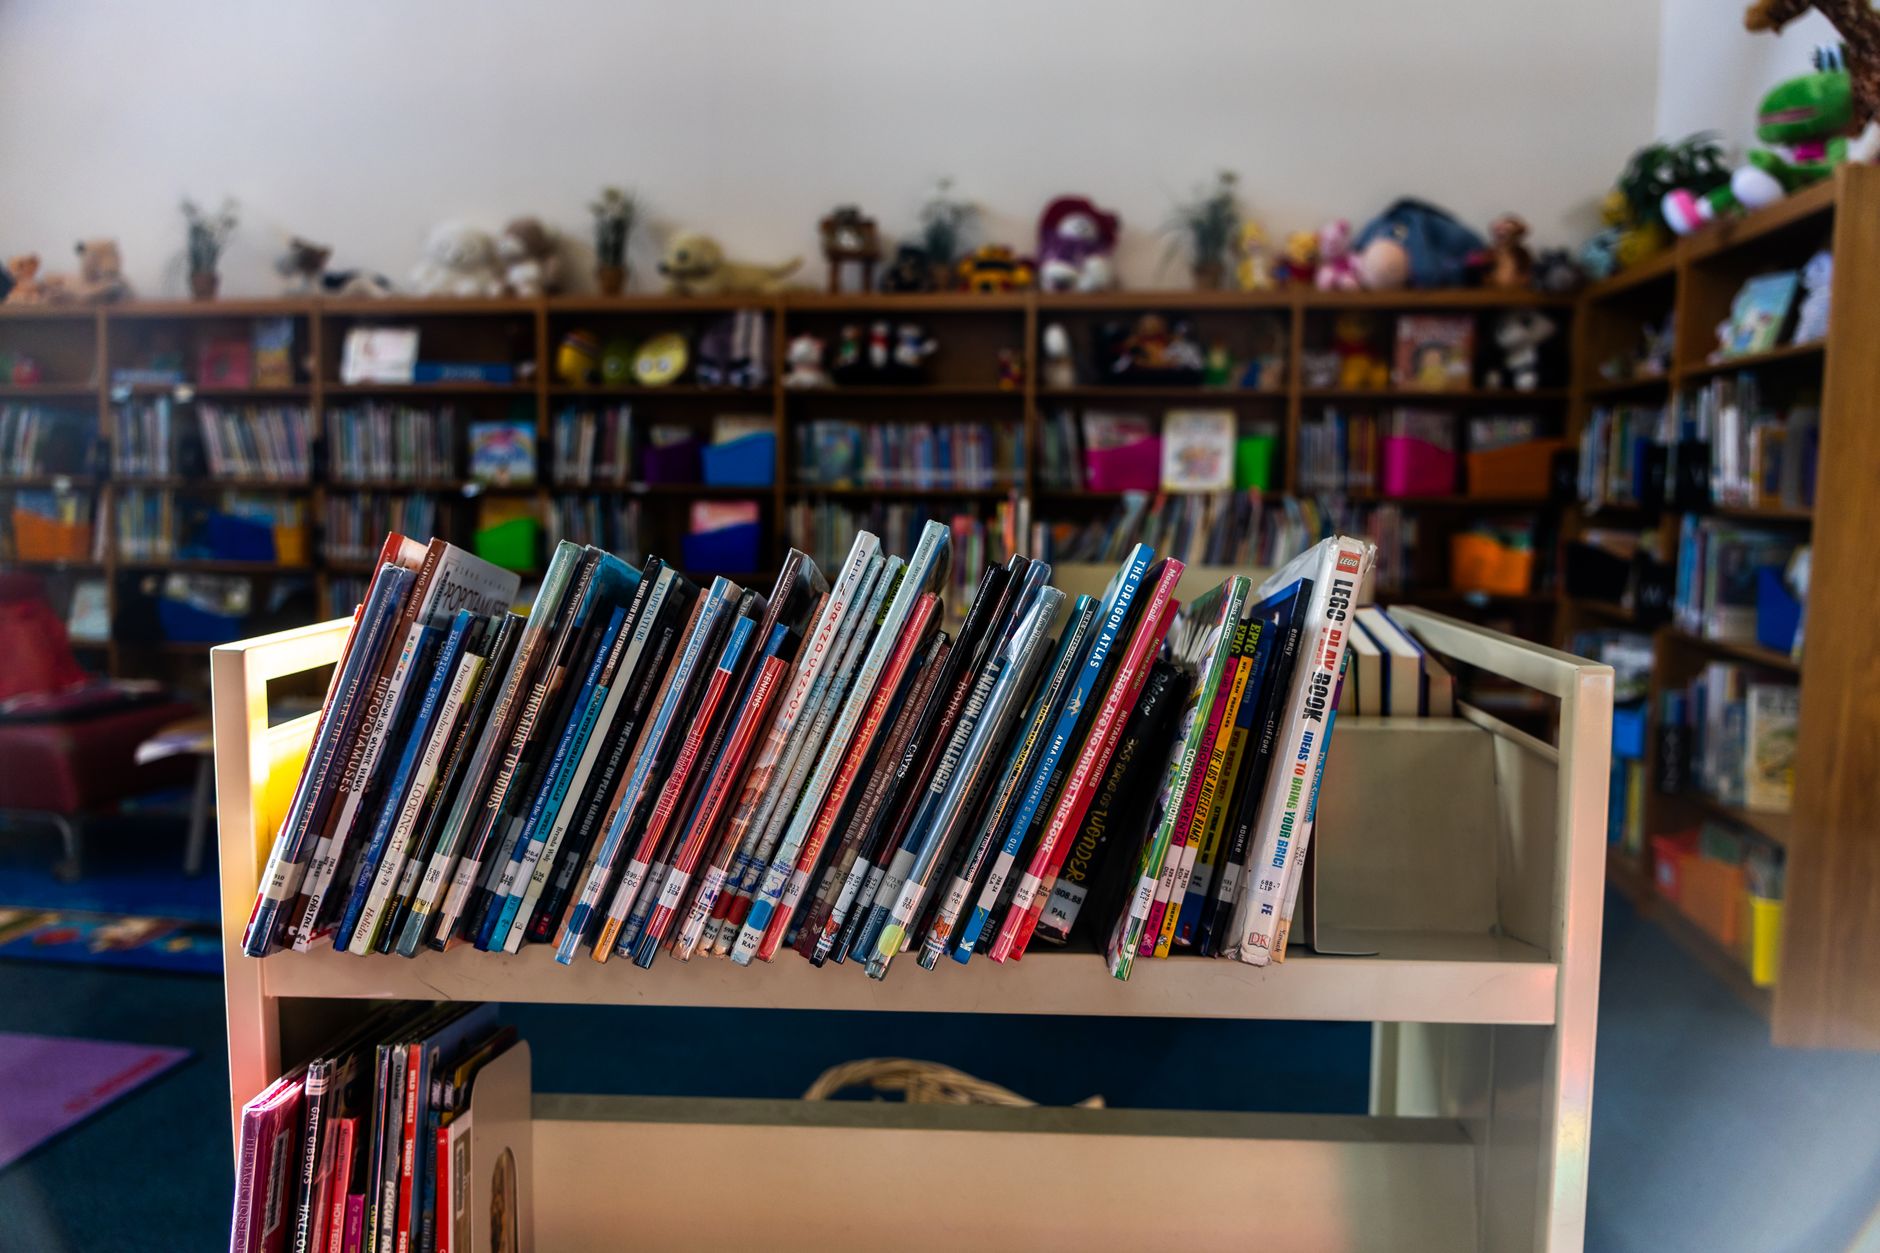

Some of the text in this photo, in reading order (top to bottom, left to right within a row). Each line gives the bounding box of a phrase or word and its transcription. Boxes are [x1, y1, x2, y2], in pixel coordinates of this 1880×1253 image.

[846, 549, 866, 581] CHIN
[908, 532, 936, 585] Rappaport Tavares
[1339, 555, 1358, 568] LEGO
[405, 586, 422, 618] ANIMALS
[1146, 567, 1176, 622] Mosco Pirolli
[605, 578, 649, 669] TRAVEL WITH THE GREAT EXPLORERS
[631, 580, 667, 643] TEMPERATURE
[1035, 616, 1046, 629] for
[1041, 608, 1049, 617] is
[1088, 558, 1145, 669] THE DRAGON ATLAS
[671, 596, 718, 693] My Teacher Likes to Say
[1022, 628, 1040, 655] Rhyme
[1144, 636, 1159, 663] Machines
[1230, 623, 1247, 654] EPIC
[1243, 623, 1262, 654] EPIC
[1301, 577, 1353, 723] LEGO PLAY BOOK
[433, 629, 458, 683] ELECTRICAL
[585, 645, 608, 686] David Stewart
[782, 600, 843, 721] GRAND CANYON
[750, 670, 773, 708] JENKINS
[807, 673, 827, 702] PALE
[1132, 670, 1144, 690] Motion
[1234, 677, 1242, 693] TEAM
[337, 677, 359, 718] POLAR
[379, 689, 396, 719] LONDON
[419, 686, 437, 719] STORMS
[488, 695, 513, 729] Eagles
[939, 680, 968, 728] BONES
[1223, 696, 1237, 728] PROFILES
[421, 663, 472, 767] Dorothy Hinshaw Patent
[566, 723, 576, 735] You
[928, 661, 999, 794] A NATION CHALLENGED
[329, 721, 343, 744] THE
[338, 675, 390, 794] HIPPOPOTAMUSES
[484, 681, 549, 811] DINOSAURS TO DODOS
[554, 734, 572, 761] Wouldn't
[1088, 709, 1127, 787] MILITARY MACHINES
[1297, 730, 1314, 761] IDEAS
[361, 735, 378, 767] OLYMPIC
[673, 755, 692, 778] book
[896, 743, 918, 778] CAVES
[1040, 666, 1132, 854] There Are No Ants in This Book
[309, 748, 333, 798] TITANIC
[351, 766, 367, 793] VENUES
[544, 777, 552, 785] to
[547, 761, 560, 778] Want
[578, 720, 634, 836] THE ATTACK ON PEARL HARBOR
[770, 765, 787, 789] Hawk
[802, 685, 890, 864] THE BURGER AND THE HOT
[1293, 761, 1307, 776] TO
[536, 796, 544, 805] on
[540, 784, 550, 797] Sail
[654, 784, 680, 819] SLOTH
[766, 788, 776, 798] of
[855, 760, 895, 840] Life During the GOLD RUSH
[1031, 768, 1062, 825] FIRST RESPONDERS
[1164, 747, 1196, 826] CICADA SYMPHONY
[1188, 748, 1224, 842] THE LOS ANGELES RAMS
[1285, 776, 1303, 809] BRING
[297, 800, 315, 832] BEAR
[389, 781, 427, 852] LOOKING AT
[531, 804, 541, 816] the
[693, 793, 718, 835] SECOND
[760, 797, 772, 813] New
[536, 810, 553, 836] POWELL
[751, 813, 766, 834] York
[1278, 809, 1296, 838] YOUR
[379, 861, 396, 886] 595.79
[988, 872, 997, 885] CLA
[991, 875, 1002, 892] 398.24
[1260, 878, 1281, 889] 688.7
[352, 906, 375, 942] Holiday
[1051, 906, 1067, 920] PAL
[741, 940, 756, 950] RAP
[742, 931, 758, 941] 974.7
[1250, 934, 1269, 946] DK
[405, 1069, 416, 1123] WILD WHEELS
[308, 1106, 319, 1132] GAIL
[245, 1136, 255, 1157] THE
[302, 1136, 315, 1184] GIBBONS
[402, 1138, 413, 1176] TORINOS
[241, 1160, 254, 1197] MAGIC
[238, 1199, 250, 1235] HORSE
